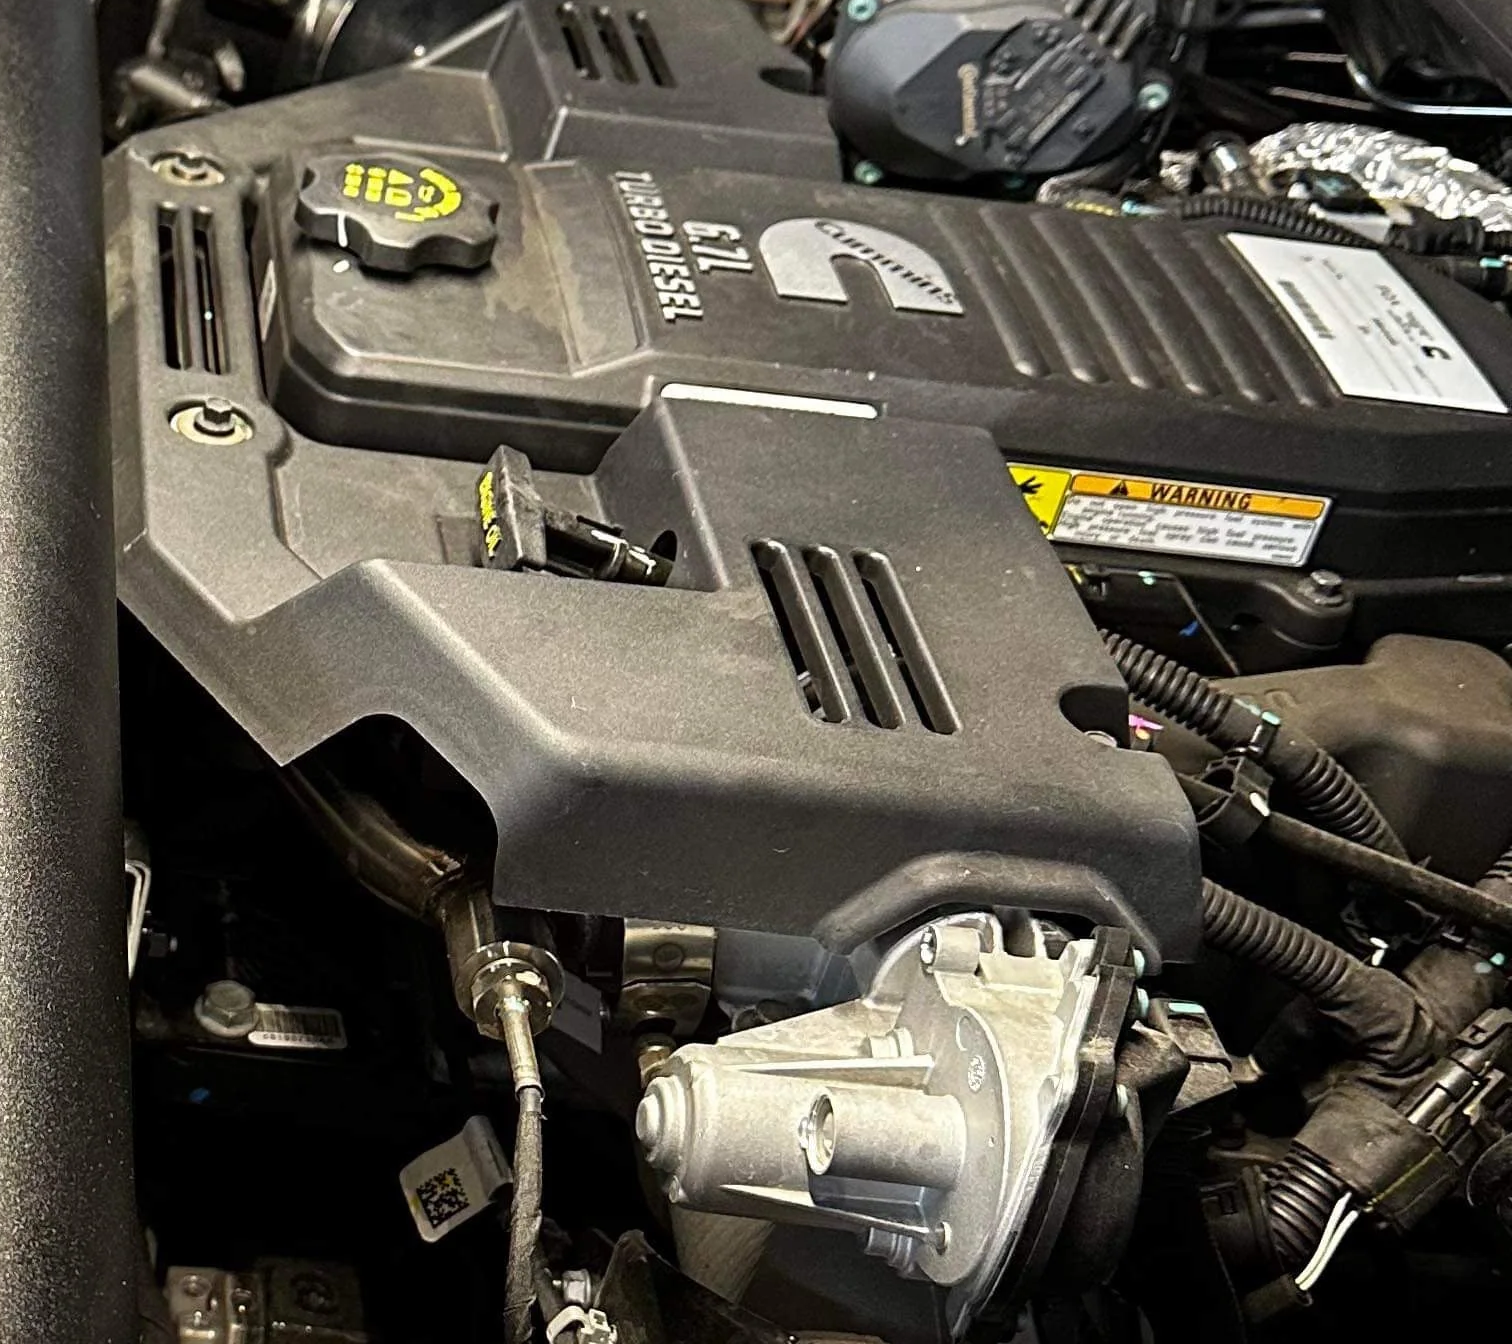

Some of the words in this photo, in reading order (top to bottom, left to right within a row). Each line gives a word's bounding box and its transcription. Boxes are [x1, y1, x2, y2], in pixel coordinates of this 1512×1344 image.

[615, 170, 675, 236] TURBO
[682, 220, 754, 273] 6.7L
[641, 237, 704, 322] DIESEL
[1151, 482, 1252, 511] WARNING
